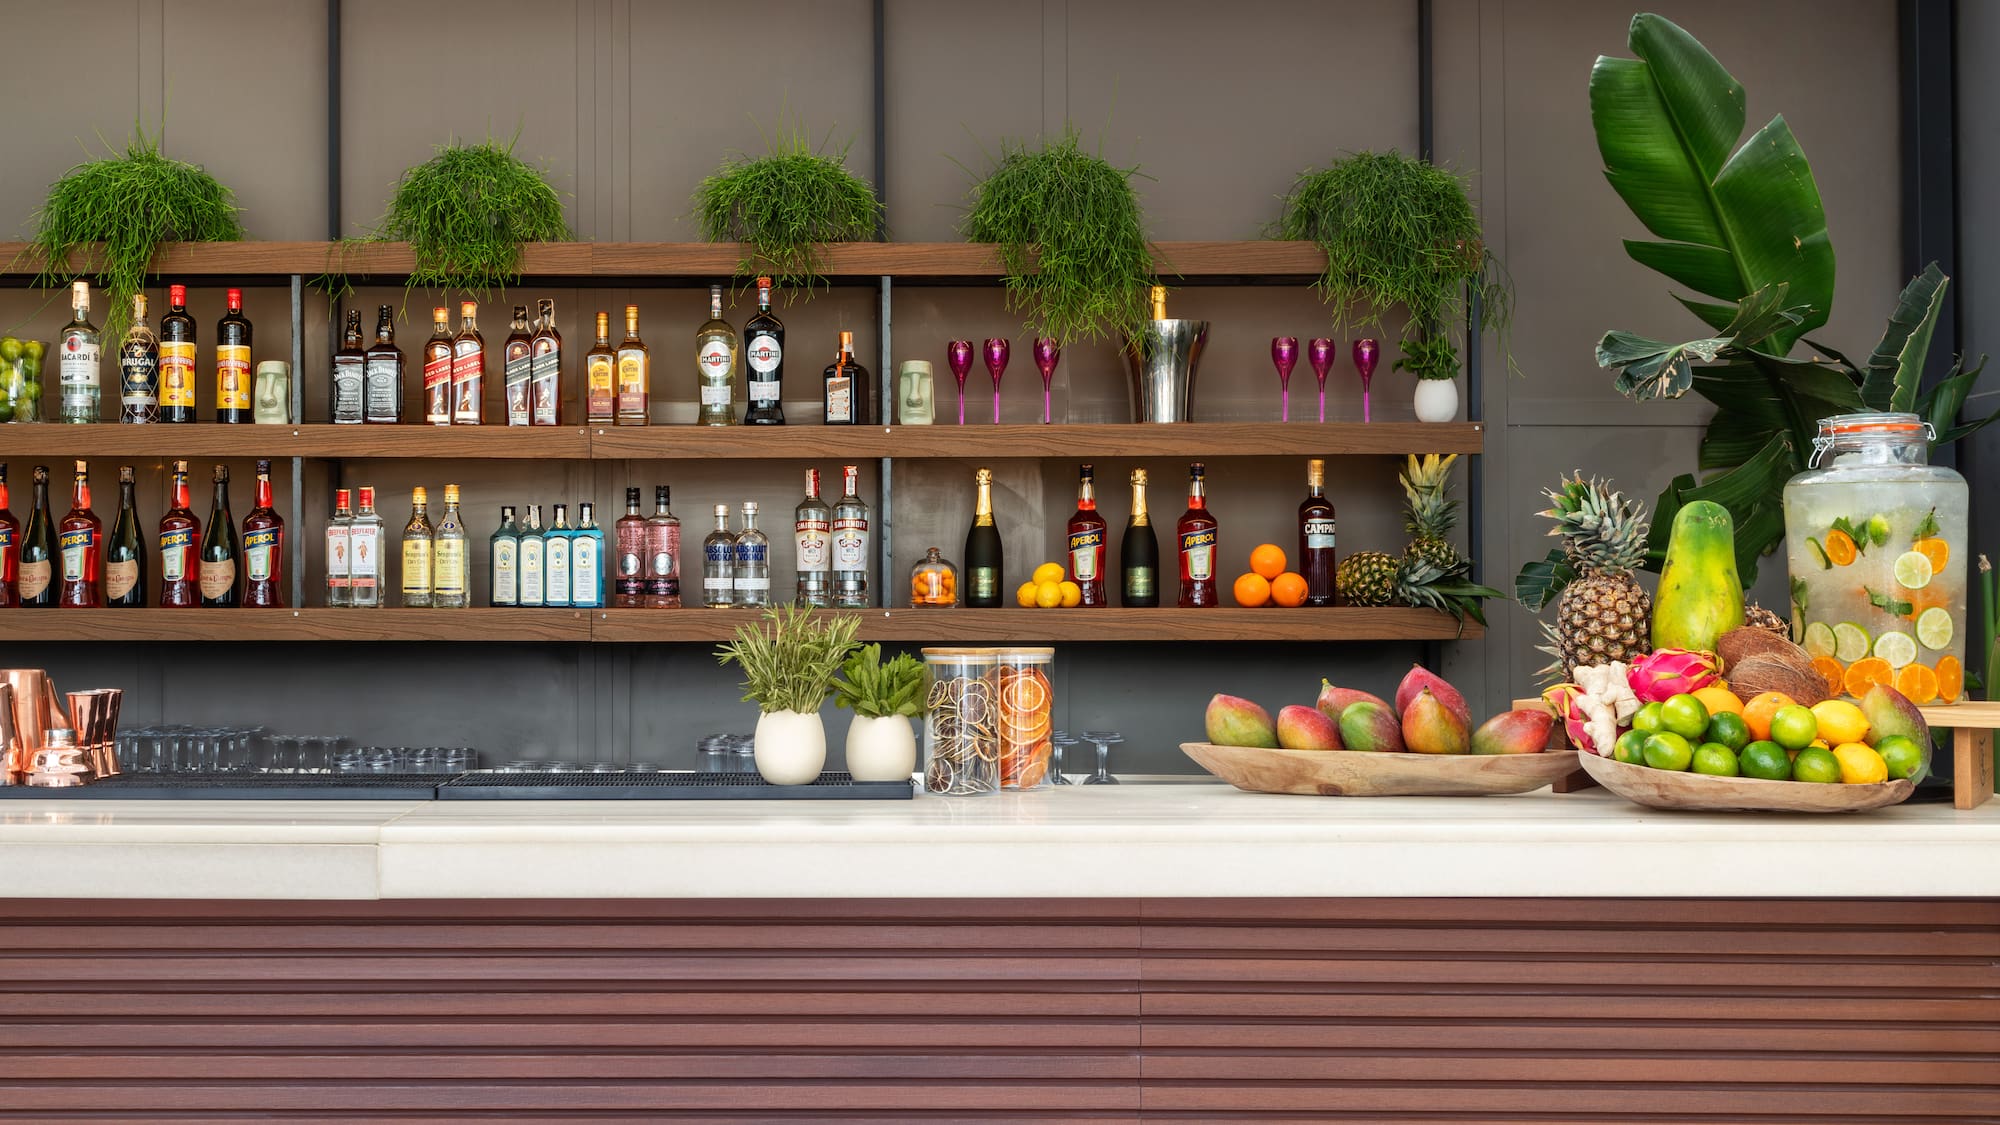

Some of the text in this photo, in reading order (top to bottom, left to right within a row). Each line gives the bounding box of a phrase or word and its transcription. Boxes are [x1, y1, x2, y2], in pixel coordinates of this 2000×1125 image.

[797, 520, 828, 530] SMIRNOFF
[834, 519, 866, 529] SMIRNOFF
[1304, 523, 1335, 534] CAMPA
[61, 534, 88, 547] APEROL
[160, 533, 188, 547] APEROL
[245, 533, 274, 547] APEROL
[1071, 533, 1101, 549] APEROL
[1185, 533, 1215, 548] APEROL
[705, 545, 732, 553] ABSOLU
[736, 545, 767, 553] ABSOLUT
[708, 553, 732, 561] VODKA
[739, 553, 764, 561] VODKA
